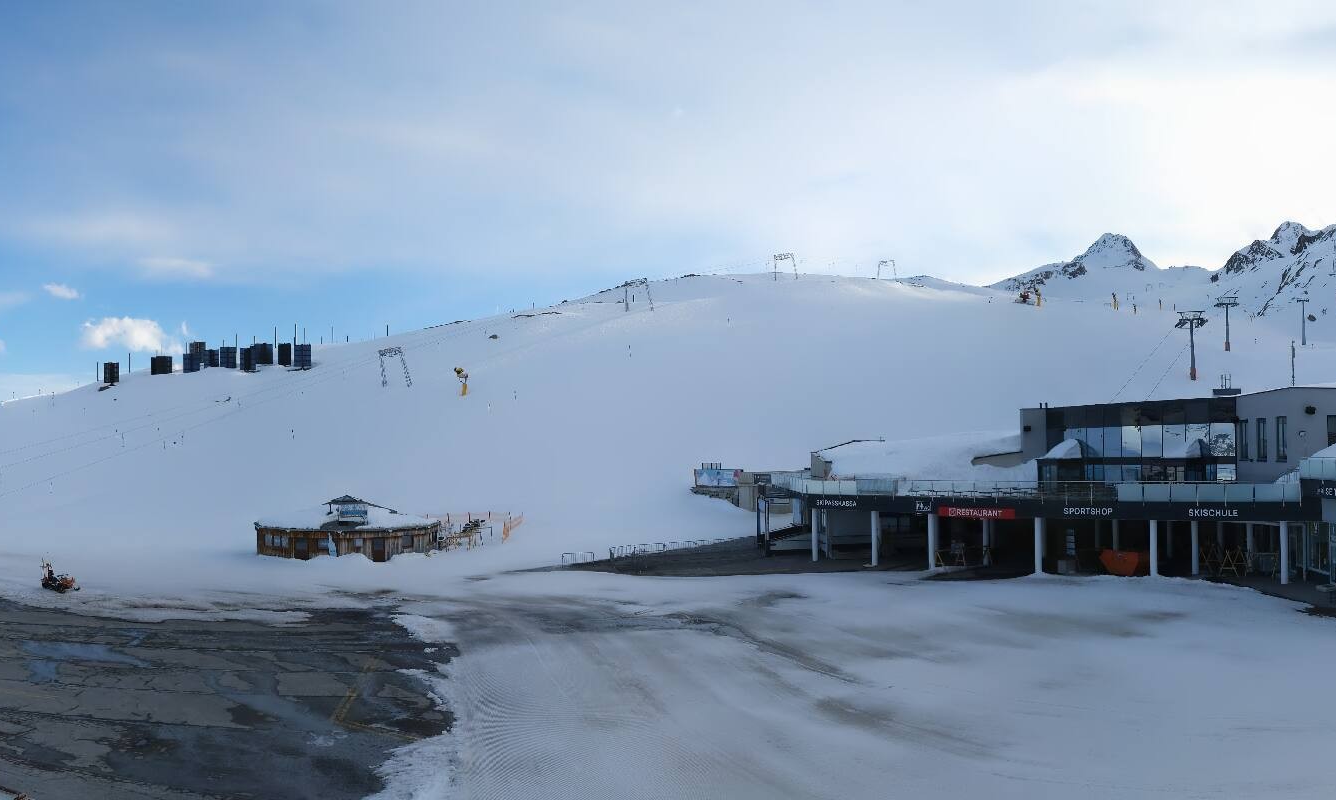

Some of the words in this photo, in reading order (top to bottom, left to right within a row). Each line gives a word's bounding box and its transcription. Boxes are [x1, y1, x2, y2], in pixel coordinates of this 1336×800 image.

[956, 508, 1002, 517] RESTAURANT
[1063, 507, 1113, 516] SPORTSHOP
[1188, 508, 1239, 517] SKISCHULE
